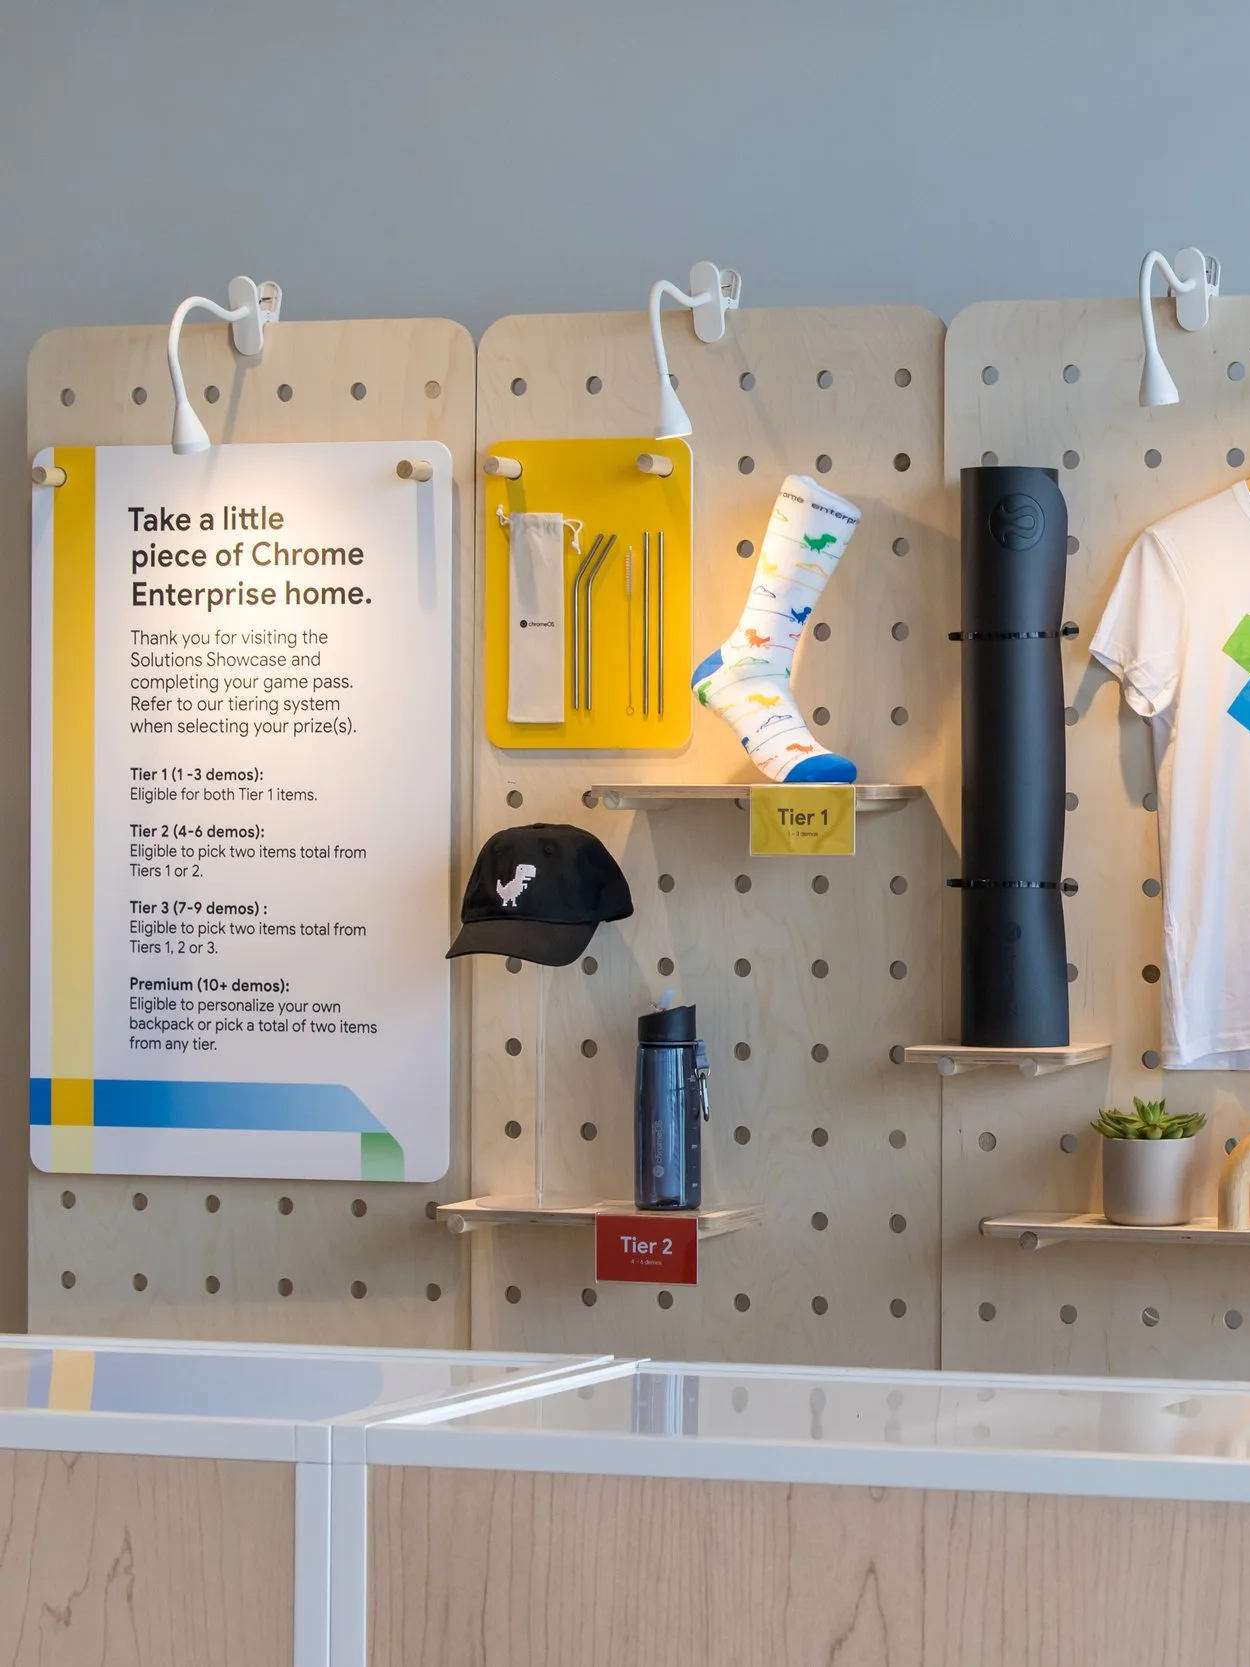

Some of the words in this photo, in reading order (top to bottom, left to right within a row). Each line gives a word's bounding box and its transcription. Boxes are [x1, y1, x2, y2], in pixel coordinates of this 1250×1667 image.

[128, 507, 191, 532] Take
[199, 513, 214, 531] a
[224, 506, 283, 530] little
[132, 543, 206, 574] piece
[216, 542, 243, 566] of
[252, 542, 364, 566] Chrome
[133, 581, 276, 612] Enterprise
[286, 581, 371, 605] home.
[131, 630, 177, 645] Thank
[182, 634, 209, 649] you
[215, 630, 237, 644] for
[242, 629, 296, 648] visiting
[302, 629, 328, 644] the
[131, 652, 202, 667] Solutions
[207, 652, 286, 667] Showcase
[292, 651, 320, 666] and
[131, 674, 218, 693] completing
[224, 678, 258, 692] your
[264, 678, 308, 693] game
[313, 677, 353, 692] pass.
[131, 696, 172, 711] Refer
[177, 698, 192, 711] to
[197, 700, 223, 711] our
[228, 696, 278, 715] tiering
[284, 697, 339, 715] system
[130, 718, 172, 733] when
[178, 718, 248, 737] selecting
[254, 722, 289, 736] your
[294, 717, 356, 737] prize(s).
[130, 768, 157, 780] Tier
[161, 768, 167, 780] 1
[206, 767, 263, 782] demos):
[131, 787, 177, 804] Eligible
[181, 787, 200, 800] for
[204, 788, 234, 800] both
[239, 787, 264, 800] Tier
[267, 788, 273, 800] 1
[277, 788, 317, 801] items.
[778, 808, 815, 825] Tier
[820, 809, 828, 826] 1
[130, 824, 157, 837] Tier
[161, 825, 169, 837] 2
[174, 824, 202, 839] (4-6
[207, 824, 264, 840] demos):
[131, 844, 177, 861] Eligible
[181, 845, 194, 857] to
[199, 844, 226, 861] pick
[230, 846, 255, 858] two
[260, 845, 296, 858] items
[300, 845, 330, 858] total
[334, 845, 366, 858] from
[130, 864, 161, 877] Tiers
[165, 864, 171, 876] 1
[174, 867, 188, 877] or
[192, 864, 203, 877] 2.
[130, 901, 157, 914] Tier
[160, 901, 170, 914] 3
[174, 900, 202, 916] (7-9
[130, 920, 177, 937] Eligible
[181, 922, 194, 934] to
[198, 921, 226, 937] pick
[229, 923, 255, 935] two
[259, 922, 296, 935] items
[300, 923, 329, 935] total
[334, 922, 366, 936] from
[130, 940, 161, 953] Tiers
[165, 941, 173, 955] 1,
[177, 941, 186, 953] 2
[189, 944, 203, 954] or
[207, 941, 218, 954] 3.
[130, 977, 193, 991] Premium
[198, 977, 227, 993] (10+
[232, 979, 289, 994] demos):
[130, 997, 176, 1014] Eligible
[181, 998, 194, 1010] to
[198, 998, 274, 1014] personalize
[278, 1003, 308, 1015] your
[312, 1003, 340, 1013] own
[130, 1017, 194, 1033] backpack
[198, 1021, 212, 1030] or
[216, 1018, 243, 1034] pick
[246, 1022, 255, 1031] a
[258, 1019, 288, 1032] total
[292, 1019, 306, 1032] of
[310, 1021, 336, 1033] two
[340, 1020, 377, 1033] items
[130, 1036, 161, 1049] from
[165, 1040, 189, 1053] any
[193, 1037, 217, 1050] tier.
[655, 1120, 663, 1164] chromeOS
[620, 1236, 657, 1254] Tier
[662, 1238, 673, 1255] 2
